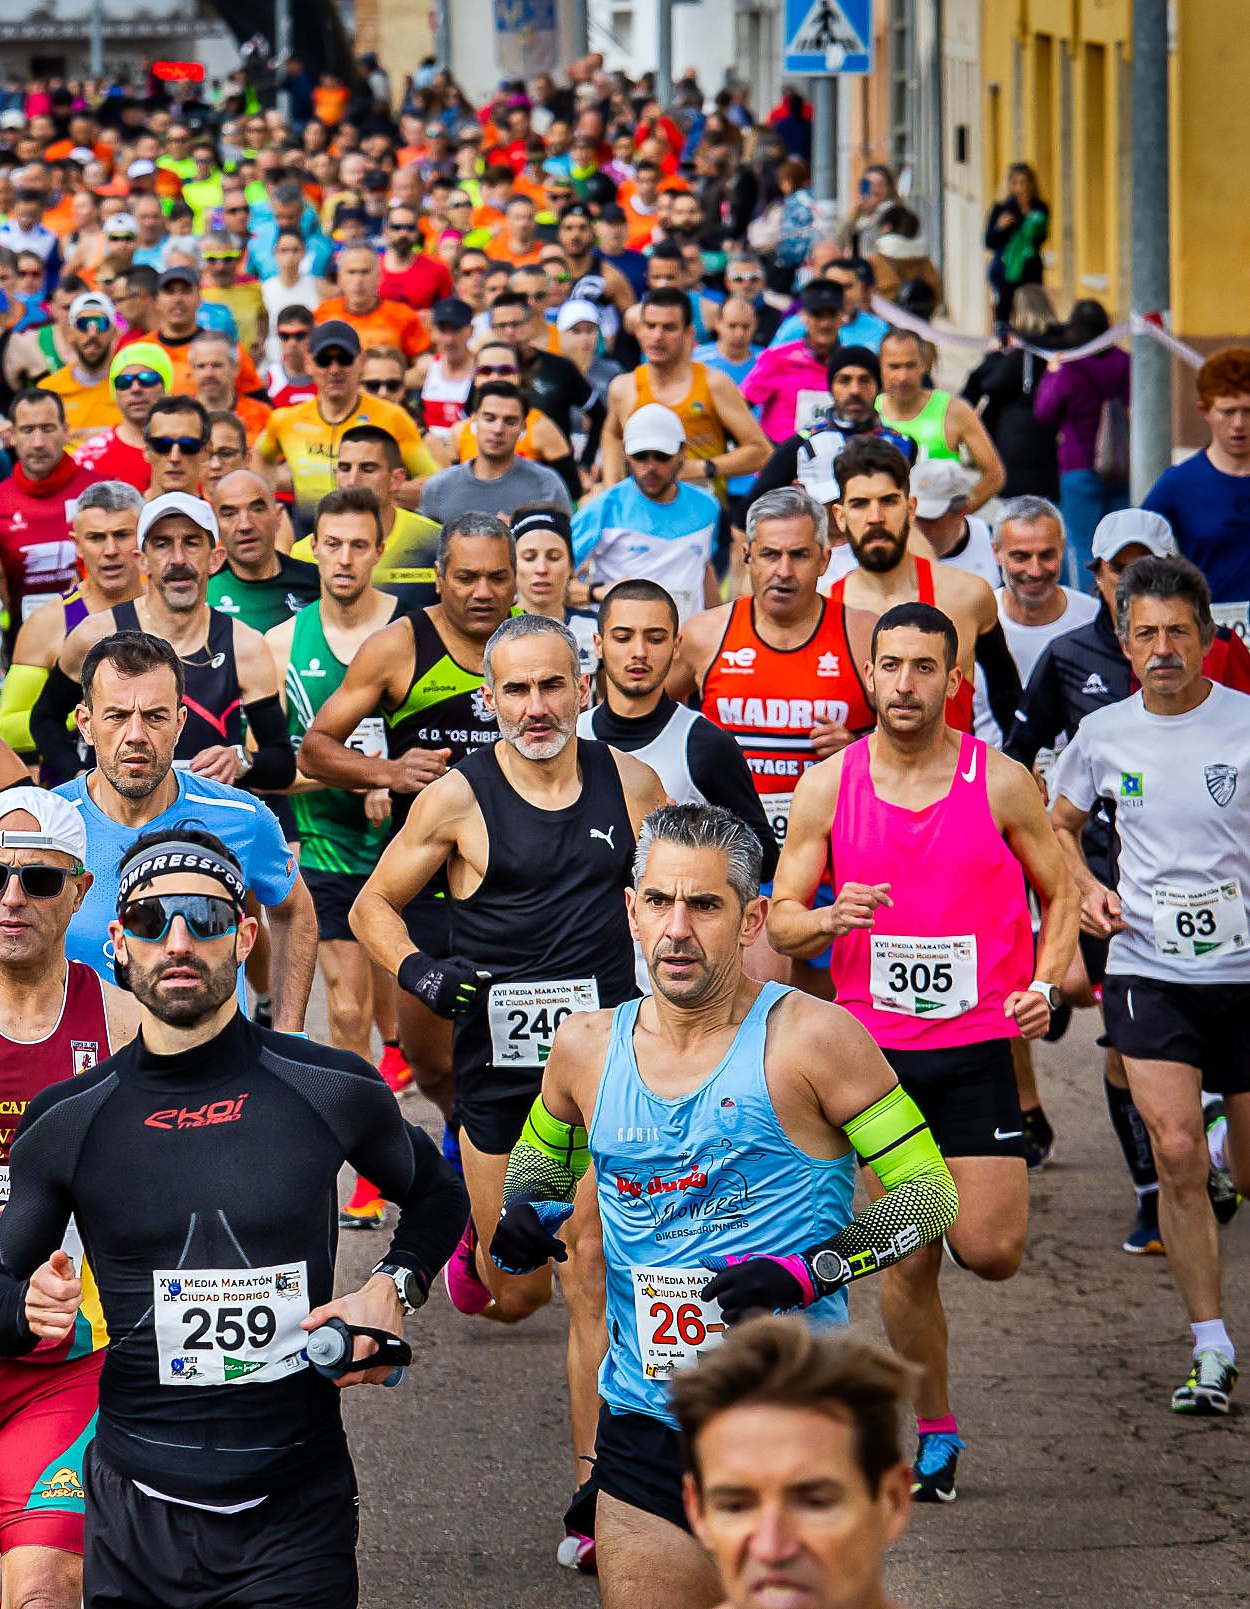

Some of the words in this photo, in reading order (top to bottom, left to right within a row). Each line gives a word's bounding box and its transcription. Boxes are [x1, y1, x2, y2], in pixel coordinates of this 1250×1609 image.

[716, 697, 849, 729] MADRID
[470, 730, 503, 742] RIBE
[119, 854, 246, 902] OMPRESSOR
[1176, 908, 1217, 938] 63
[888, 962, 953, 993] 305
[509, 988, 533, 997] MEDIA
[184, 1278, 218, 1288] MEDIA
[221, 1275, 273, 1288] MARATÓN
[636, 1274, 655, 1284] XVII
[656, 1275, 685, 1285] MEDIA
[687, 1276, 716, 1286] MARA
[163, 1294, 177, 1302] DE
[179, 1293, 220, 1302] CIUDAD
[223, 1291, 270, 1302] RODRIGO
[655, 1288, 688, 1299] CIUDAD
[181, 1305, 277, 1352] 259
[649, 1301, 726, 1346] 26
[41, 1488, 85, 1499] austra
